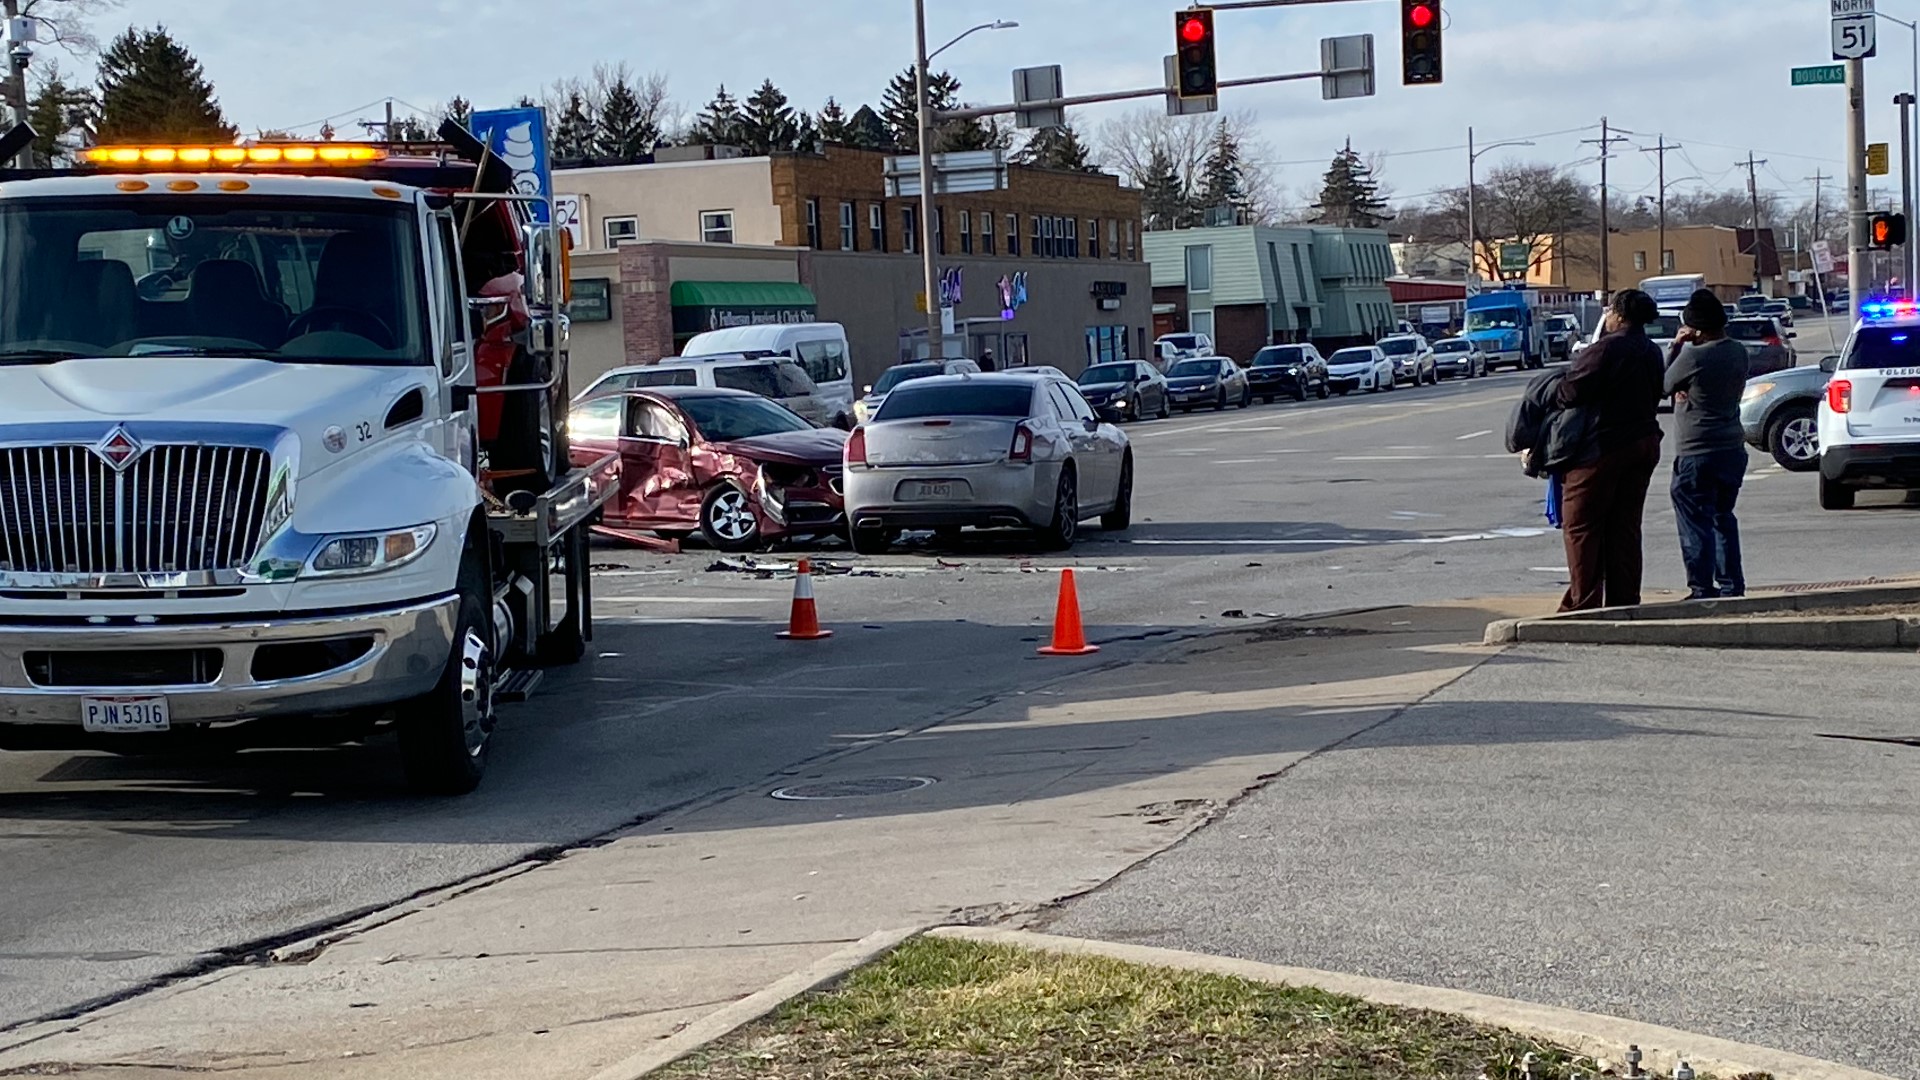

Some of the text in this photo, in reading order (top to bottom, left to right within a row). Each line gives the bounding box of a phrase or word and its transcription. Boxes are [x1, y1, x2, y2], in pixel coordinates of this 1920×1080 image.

[1833, 0, 1873, 12] NORTH
[1842, 25, 1866, 49] 51
[1795, 67, 1843, 83] DOUGLAS
[555, 200, 578, 225] 52
[355, 421, 373, 442] 32
[88, 704, 162, 725] PJN 5316
